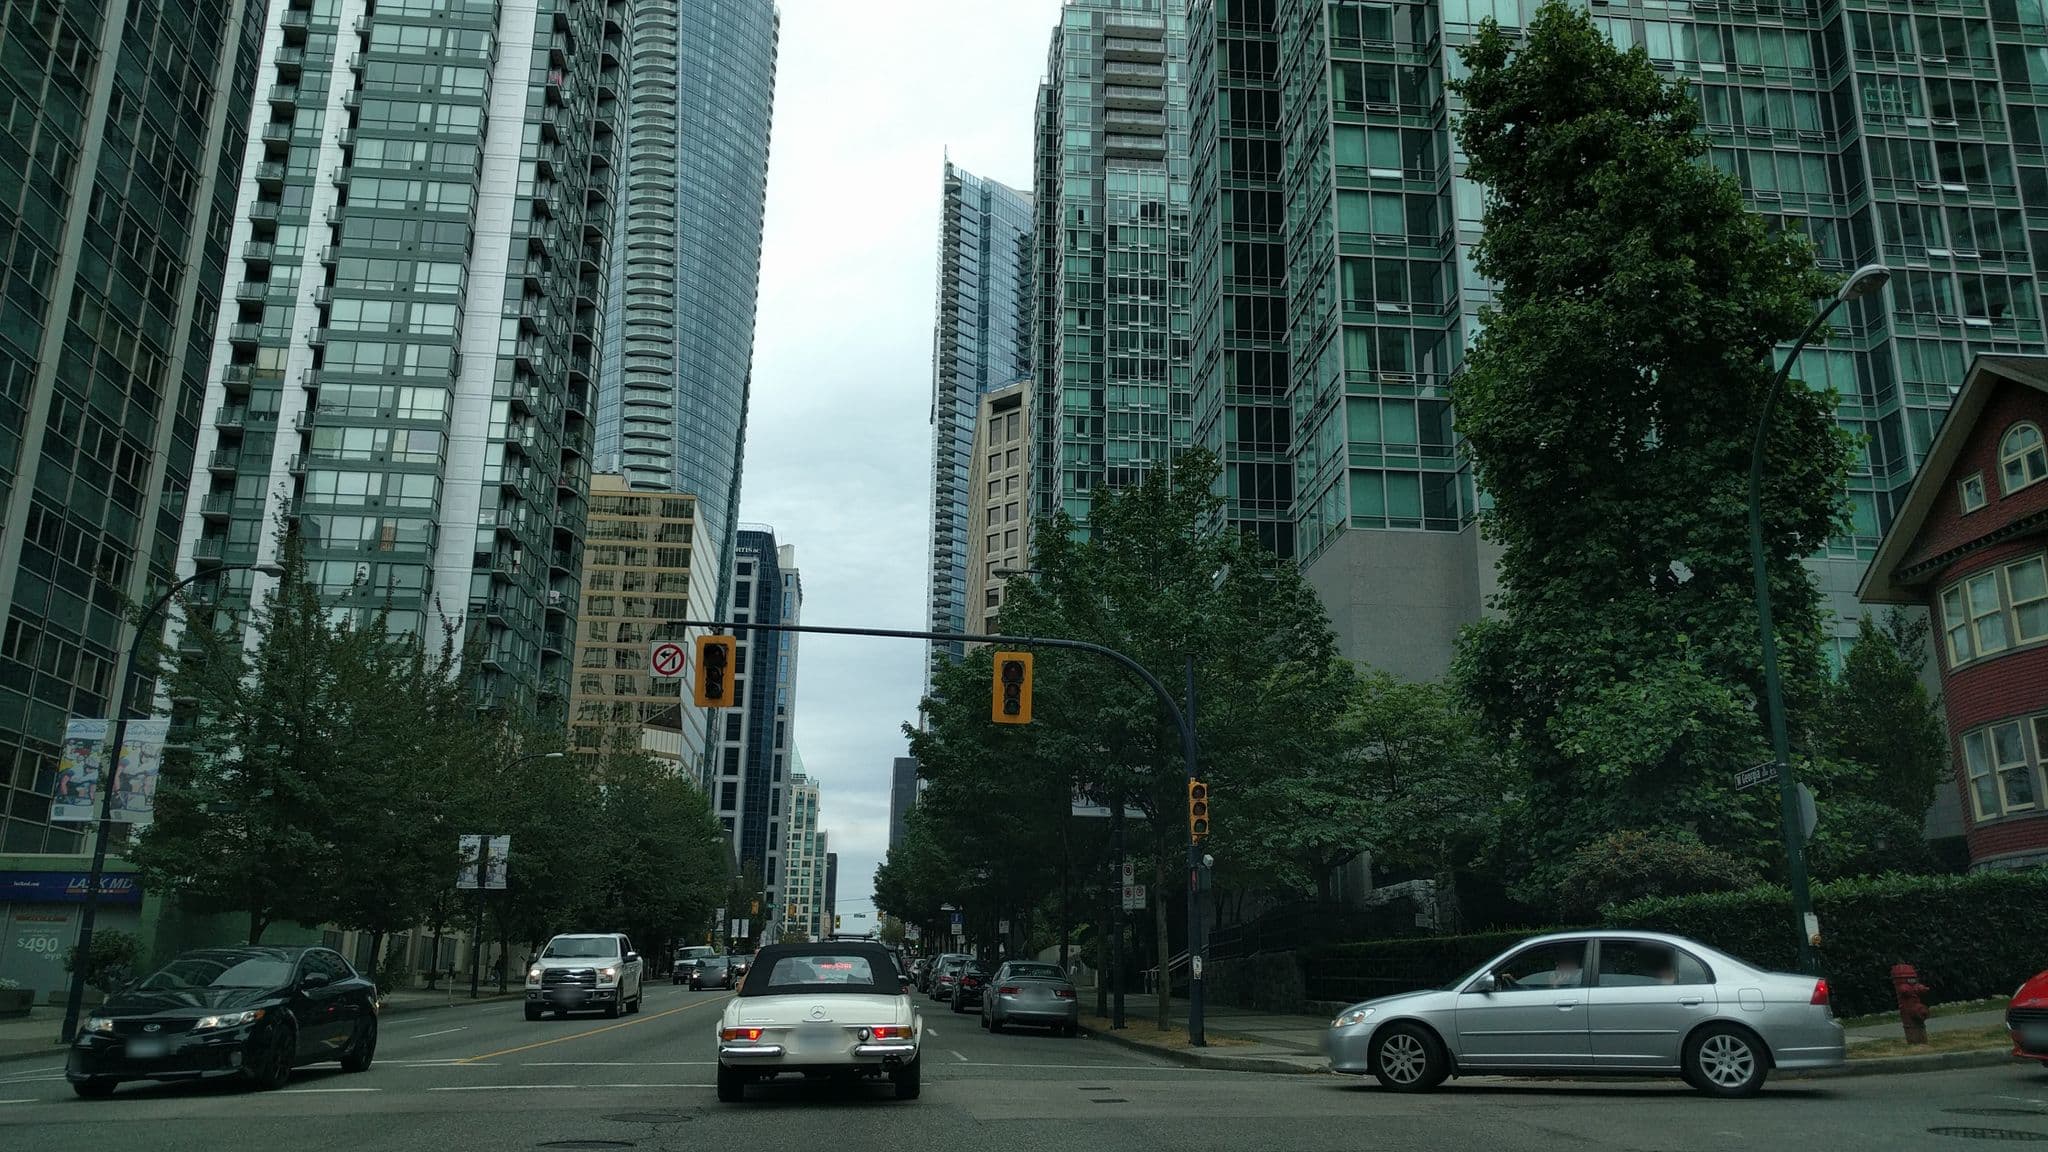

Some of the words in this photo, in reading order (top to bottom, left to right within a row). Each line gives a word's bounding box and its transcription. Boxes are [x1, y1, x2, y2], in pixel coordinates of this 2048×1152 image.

[1741, 769, 1761, 785] Georgia
[67, 878, 109, 889] LAK
[109, 878, 132, 889] MD
[16, 937, 59, 953] $490
